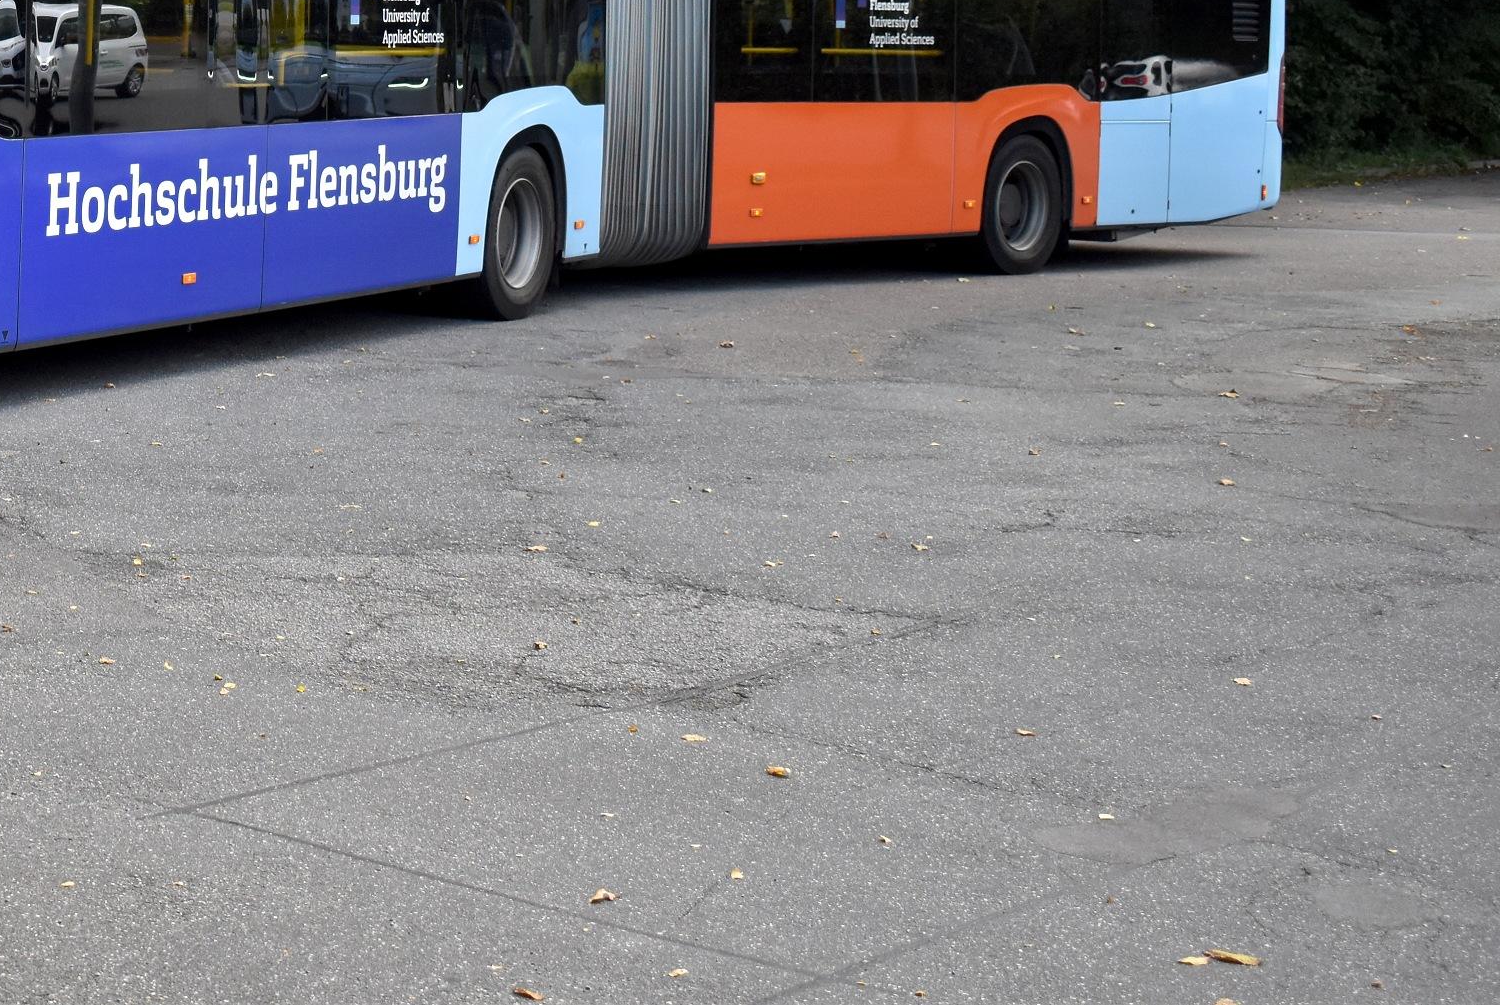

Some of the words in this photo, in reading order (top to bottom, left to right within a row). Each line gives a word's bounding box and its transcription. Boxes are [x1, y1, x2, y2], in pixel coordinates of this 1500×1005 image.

[382, 8, 420, 26] University
[421, 8, 430, 23] of
[869, 16, 910, 31] University
[910, 16, 919, 28] of
[382, 29, 412, 48] Applied
[412, 30, 444, 44] Sciences
[869, 32, 900, 48] Applied
[900, 32, 935, 45] Sciences
[46, 154, 277, 237] Hochschule
[287, 144, 447, 213] Flensburg
